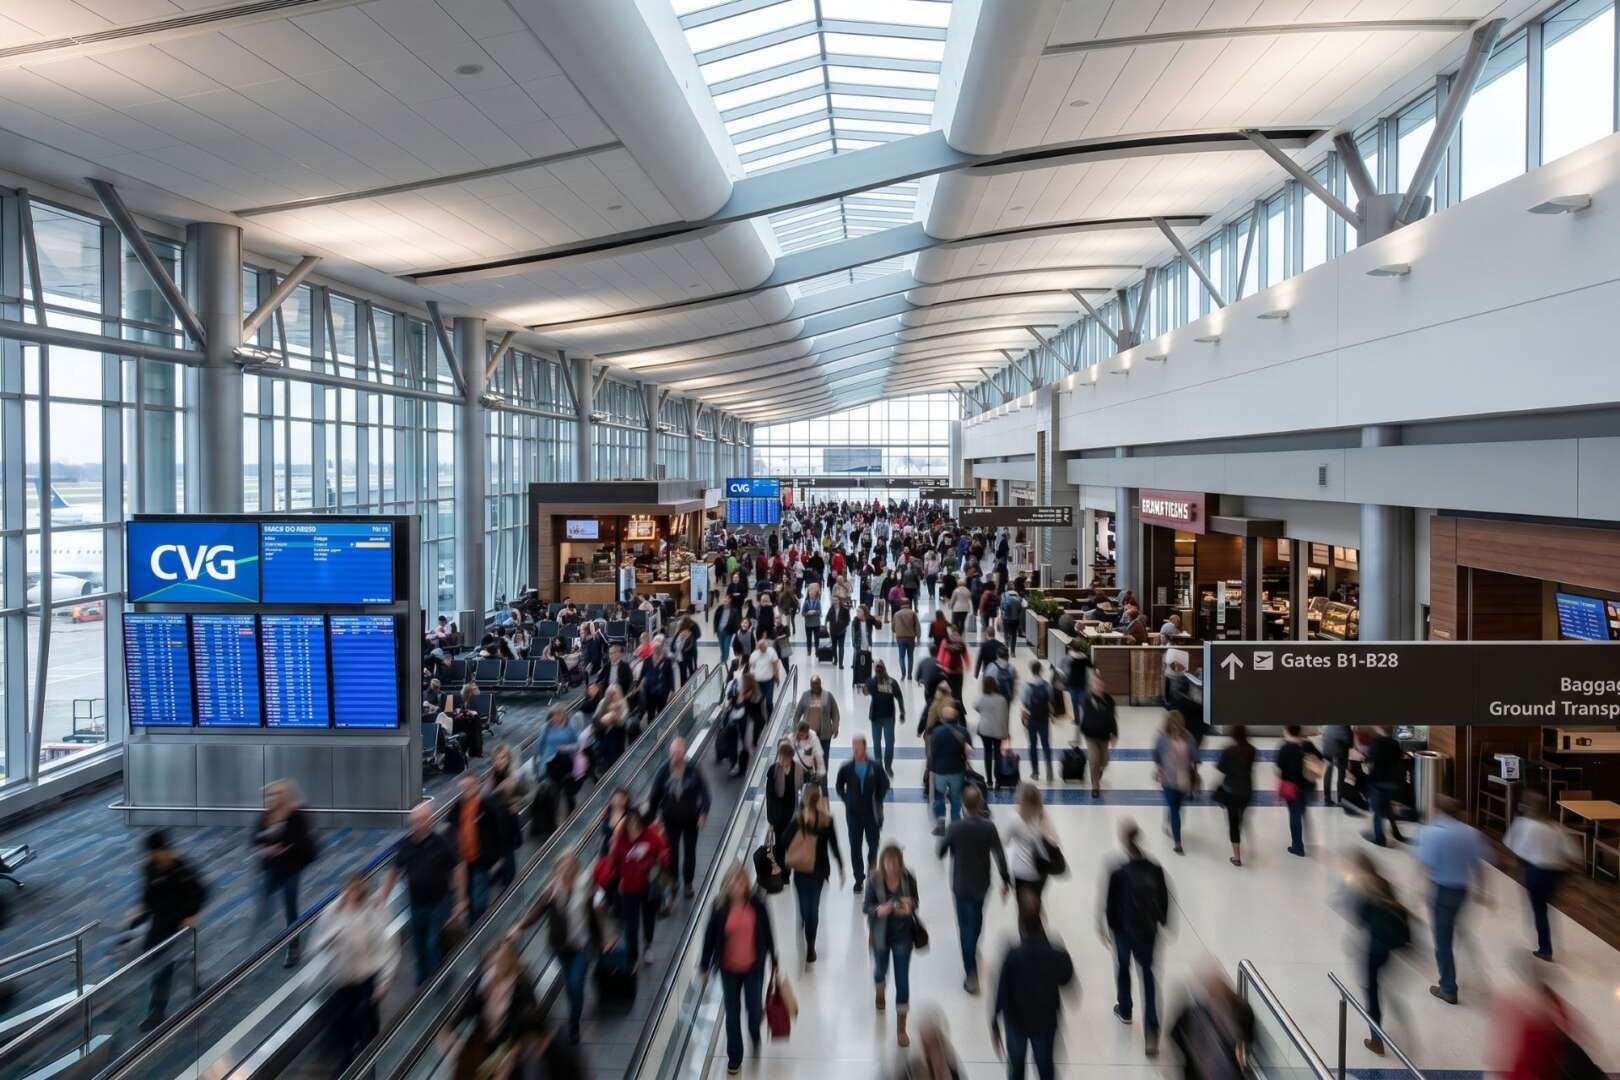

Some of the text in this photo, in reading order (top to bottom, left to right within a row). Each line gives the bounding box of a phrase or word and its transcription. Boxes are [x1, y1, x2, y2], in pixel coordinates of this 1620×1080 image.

[730, 483, 750, 493] CVG
[150, 544, 236, 580] CVG
[1281, 653, 1399, 668] Gates B1-B28
[1489, 700, 1620, 720] Ground Transp
